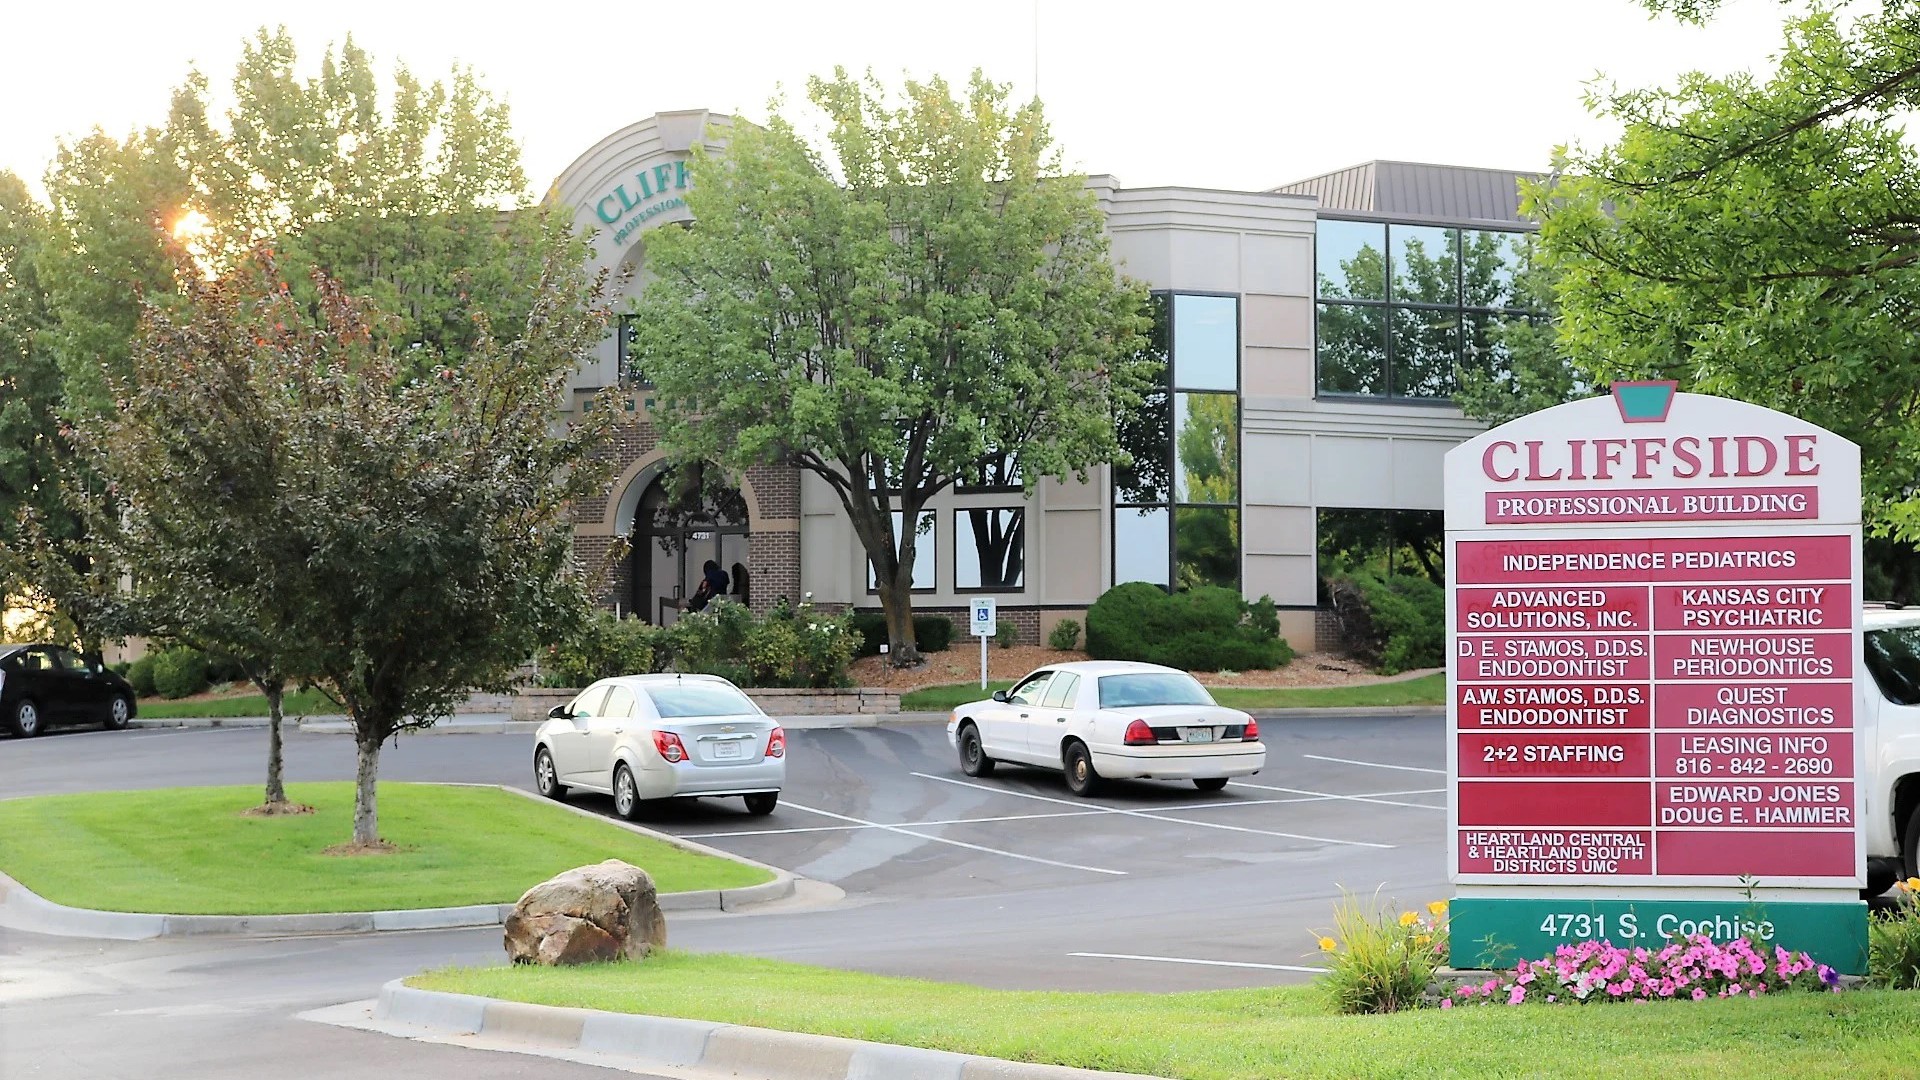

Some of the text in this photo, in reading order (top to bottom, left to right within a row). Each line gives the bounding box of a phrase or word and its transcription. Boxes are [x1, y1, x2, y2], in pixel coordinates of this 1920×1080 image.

[596, 161, 690, 224] CLIFF
[1482, 435, 1820, 483] CLIFFSIDE
[1496, 493, 1808, 516] PROFESSIONAL BUILDING
[1503, 552, 1666, 571] INDEPENDENCE
[1671, 550, 1796, 569] PEDIATRICS
[1491, 590, 1606, 608] ADVANCED
[1682, 587, 1824, 606] KANSAS CITY
[1467, 610, 1638, 631] SOLUTIONS, INC.
[1683, 608, 1823, 627] PSYCHIATRIC
[1458, 639, 1648, 660] D. E. STAMOS, D.D.S.
[1691, 638, 1815, 656] NEWHOUSE
[1478, 659, 1629, 677] ENDODONTIST
[1673, 657, 1833, 676] PERIODONTICS
[1503, 687, 1588, 707] STAMOS,
[1594, 687, 1645, 704] D.D.S.
[1717, 686, 1789, 706] QUEST
[1480, 708, 1629, 725] ENDODONTIST
[1687, 707, 1834, 725] DIAGNOSTICS
[1483, 745, 1624, 762] 2+2 STAFFING
[1681, 736, 1828, 755] LEASING INFO
[1675, 757, 1712, 774] 816
[1729, 757, 1767, 775] 842
[1784, 757, 1833, 775] 2690
[1670, 785, 1840, 803] EDWARD JONES
[1661, 806, 1851, 824] DOUG E. HAMMER
[1466, 832, 1646, 847] HEARTLAND CENTRAL
[1468, 845, 1643, 860] & HEARTLAND SOUTH
[1493, 859, 1618, 874] DISTRICTS UMC
[1540, 913, 1605, 940] 4731
[1618, 913, 1646, 939] S.
